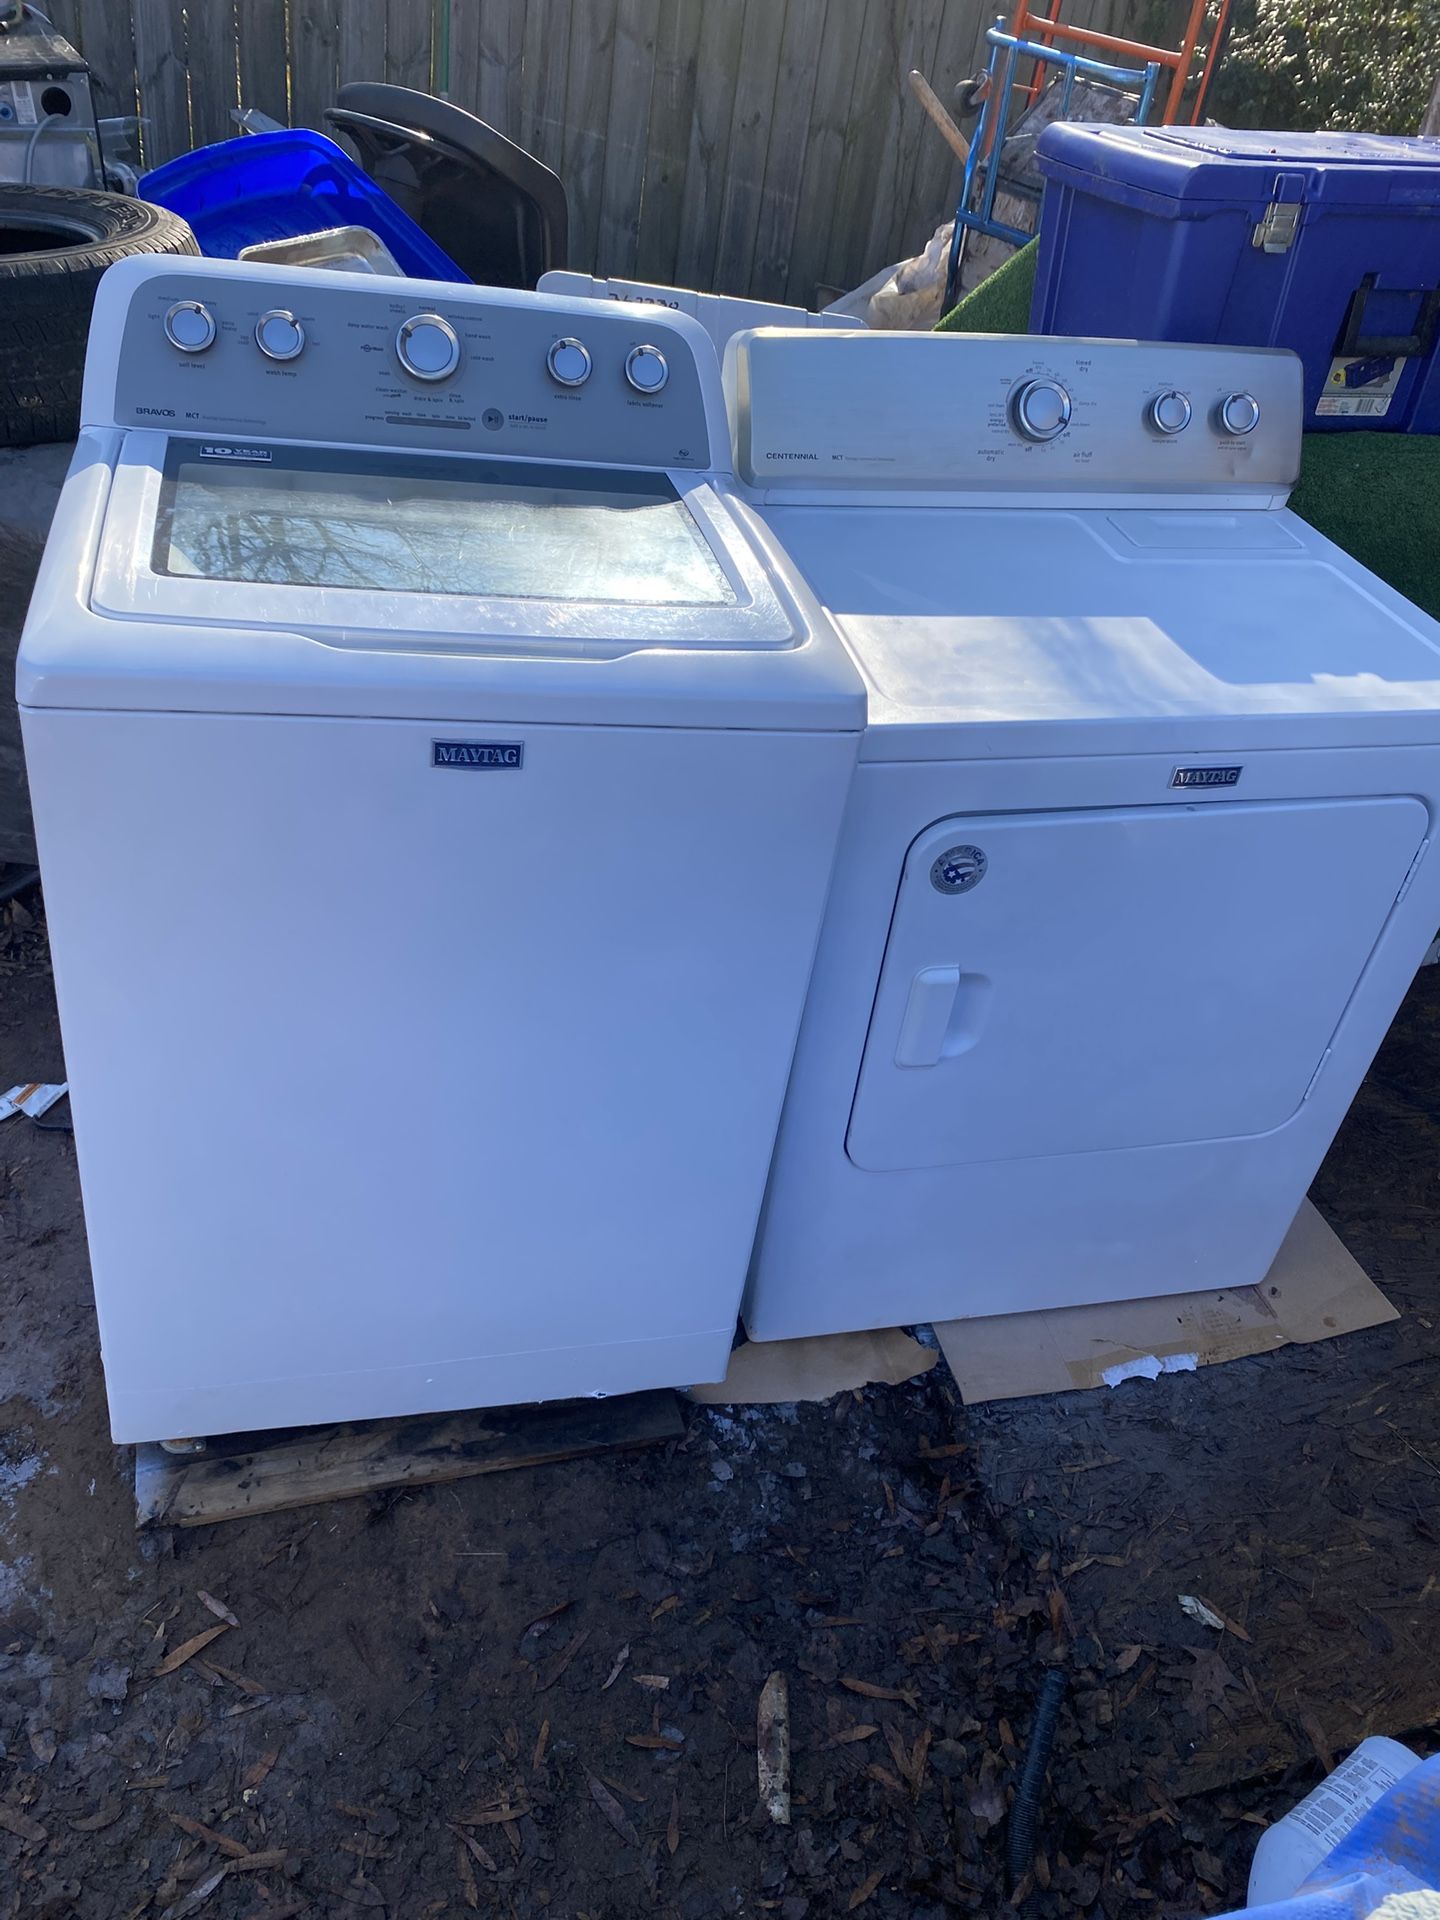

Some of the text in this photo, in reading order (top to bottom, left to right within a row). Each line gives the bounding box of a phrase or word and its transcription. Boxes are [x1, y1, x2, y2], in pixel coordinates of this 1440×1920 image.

[135, 406, 176, 419] BRAVOS
[185, 411, 200, 421] MCT
[508, 412, 549, 425] start/pause
[204, 446, 232, 455] 10
[765, 451, 820, 461] CENTENNIAL
[977, 448, 1005, 456] automatic
[437, 746, 519, 764] MAYTAG
[1176, 769, 1238, 784] MAYTAG
